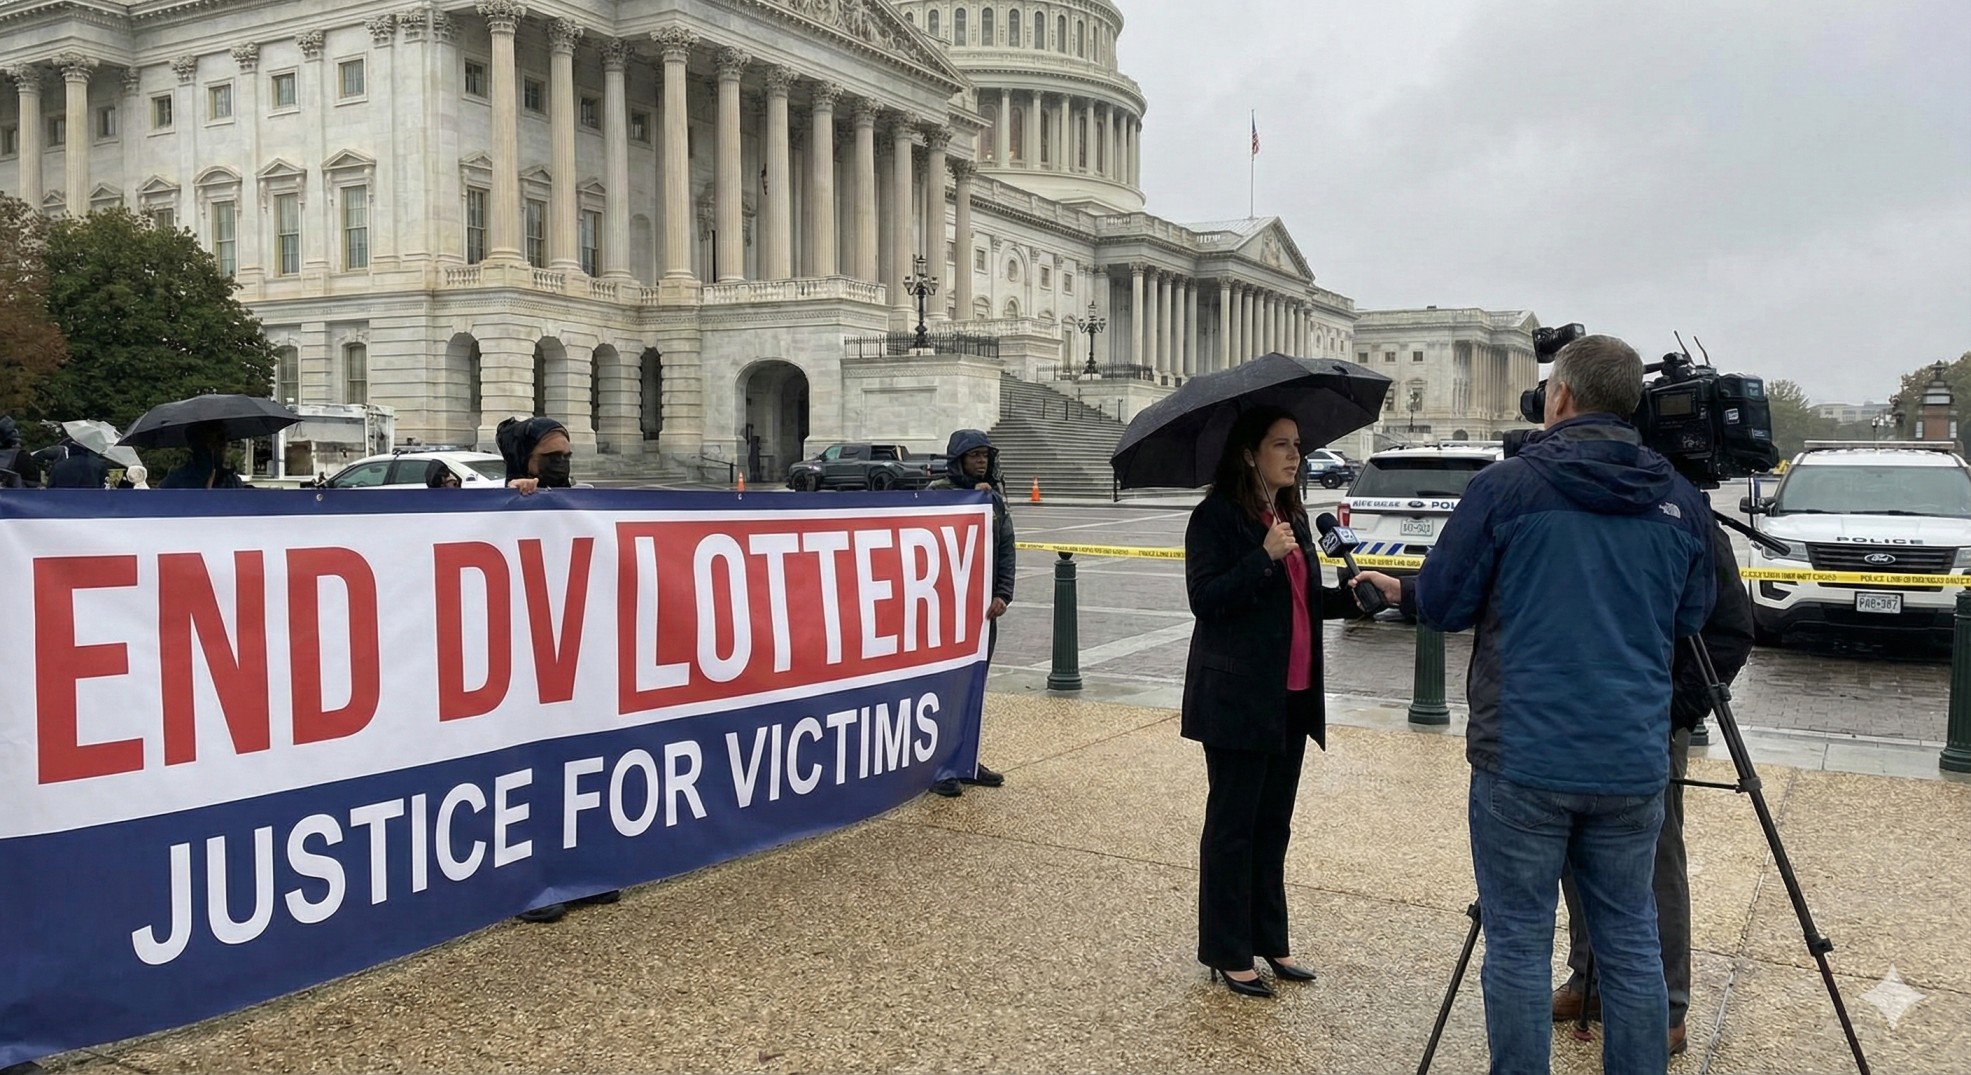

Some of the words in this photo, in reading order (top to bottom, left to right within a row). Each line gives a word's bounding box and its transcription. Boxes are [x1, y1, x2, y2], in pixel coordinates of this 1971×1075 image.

[34, 548, 379, 785] END
[434, 538, 593, 721] DV
[634, 524, 979, 692] LOTTERY
[1837, 536, 1923, 545] POLICE
[131, 768, 534, 965] JUSTICE
[563, 739, 708, 849] FOR
[725, 691, 941, 808] VICTIMS
